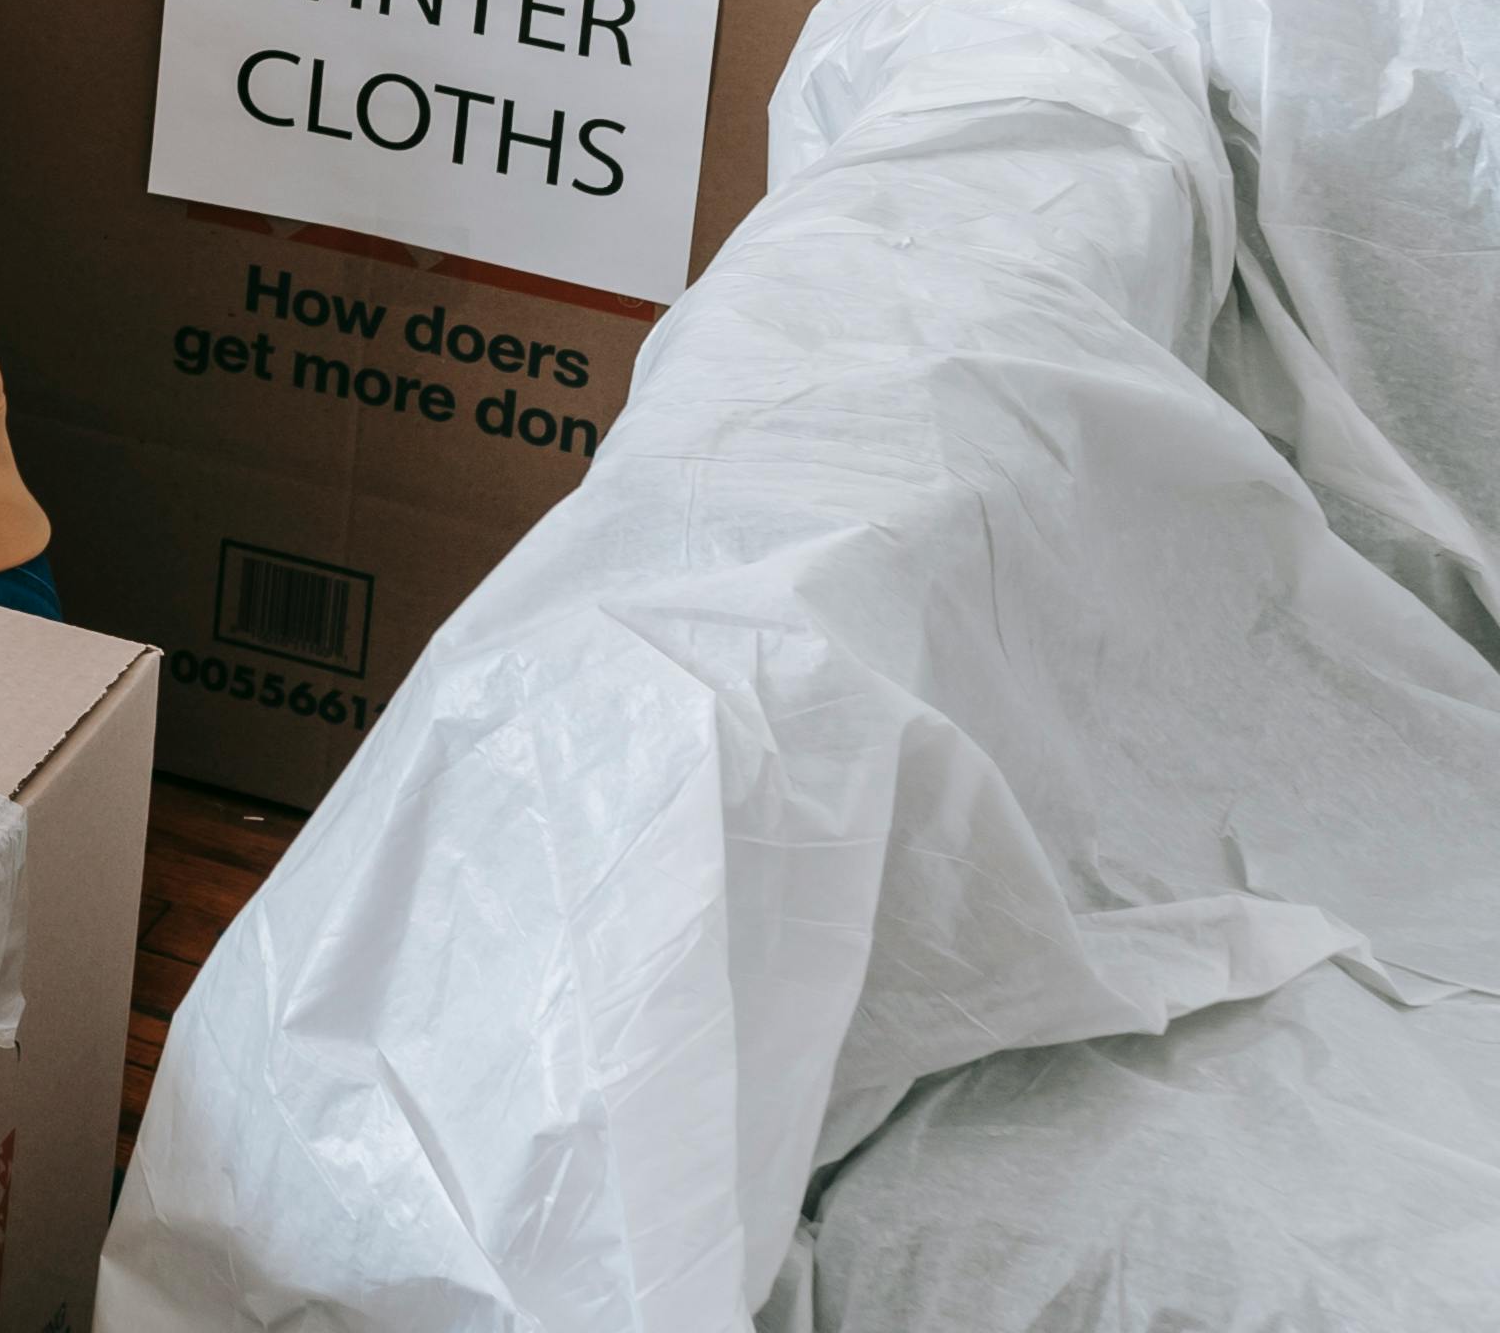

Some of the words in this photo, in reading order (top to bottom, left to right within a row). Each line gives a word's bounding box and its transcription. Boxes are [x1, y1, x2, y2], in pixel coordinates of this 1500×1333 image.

[236, 48, 626, 197] CLOTHS
[173, 326, 272, 381] get
[293, 347, 455, 423] more
[246, 264, 385, 339] How
[404, 304, 591, 388] doers
[171, 650, 387, 731] 0055661
